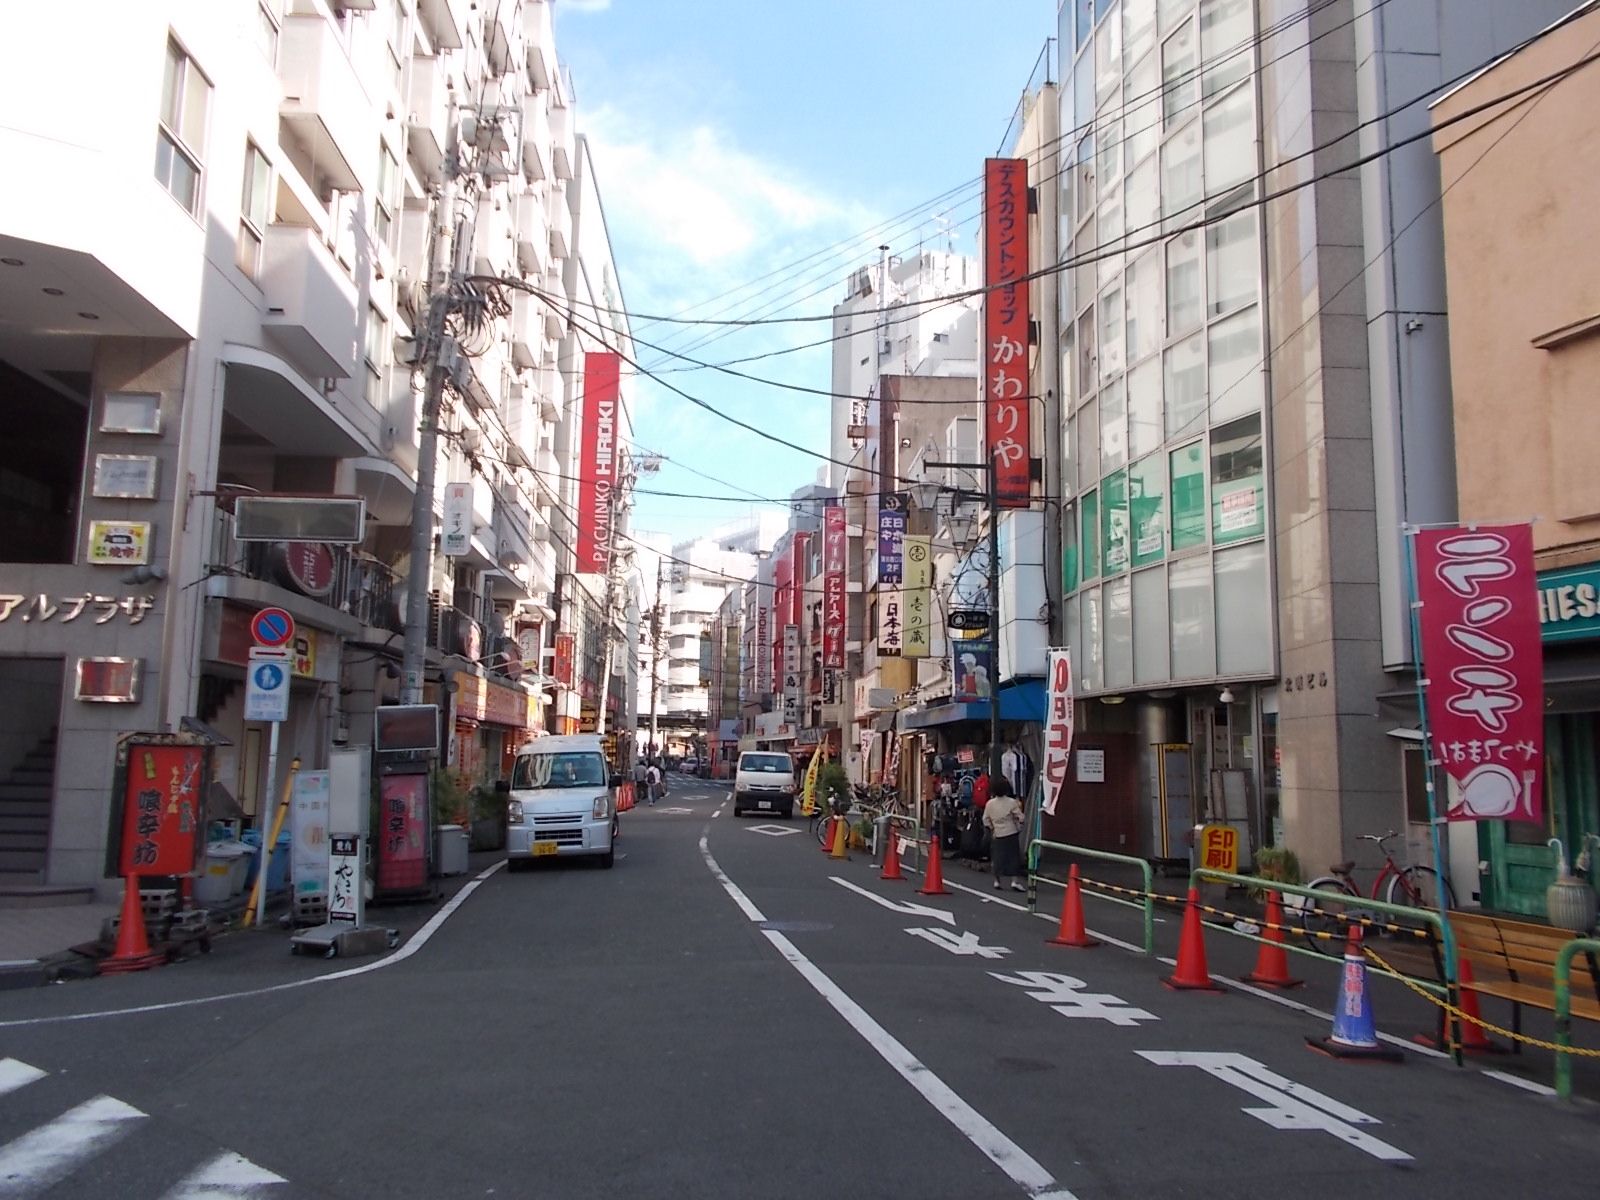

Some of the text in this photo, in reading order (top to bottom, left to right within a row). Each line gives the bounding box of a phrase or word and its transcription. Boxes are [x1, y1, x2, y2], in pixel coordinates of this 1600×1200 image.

[992, 335, 1024, 469] かわりや
[593, 401, 614, 563] PACHINKO HIROKI
[1537, 583, 1600, 624] HES
[1205, 829, 1235, 870] 印刷
[904, 927, 1416, 1161] 止まれ
